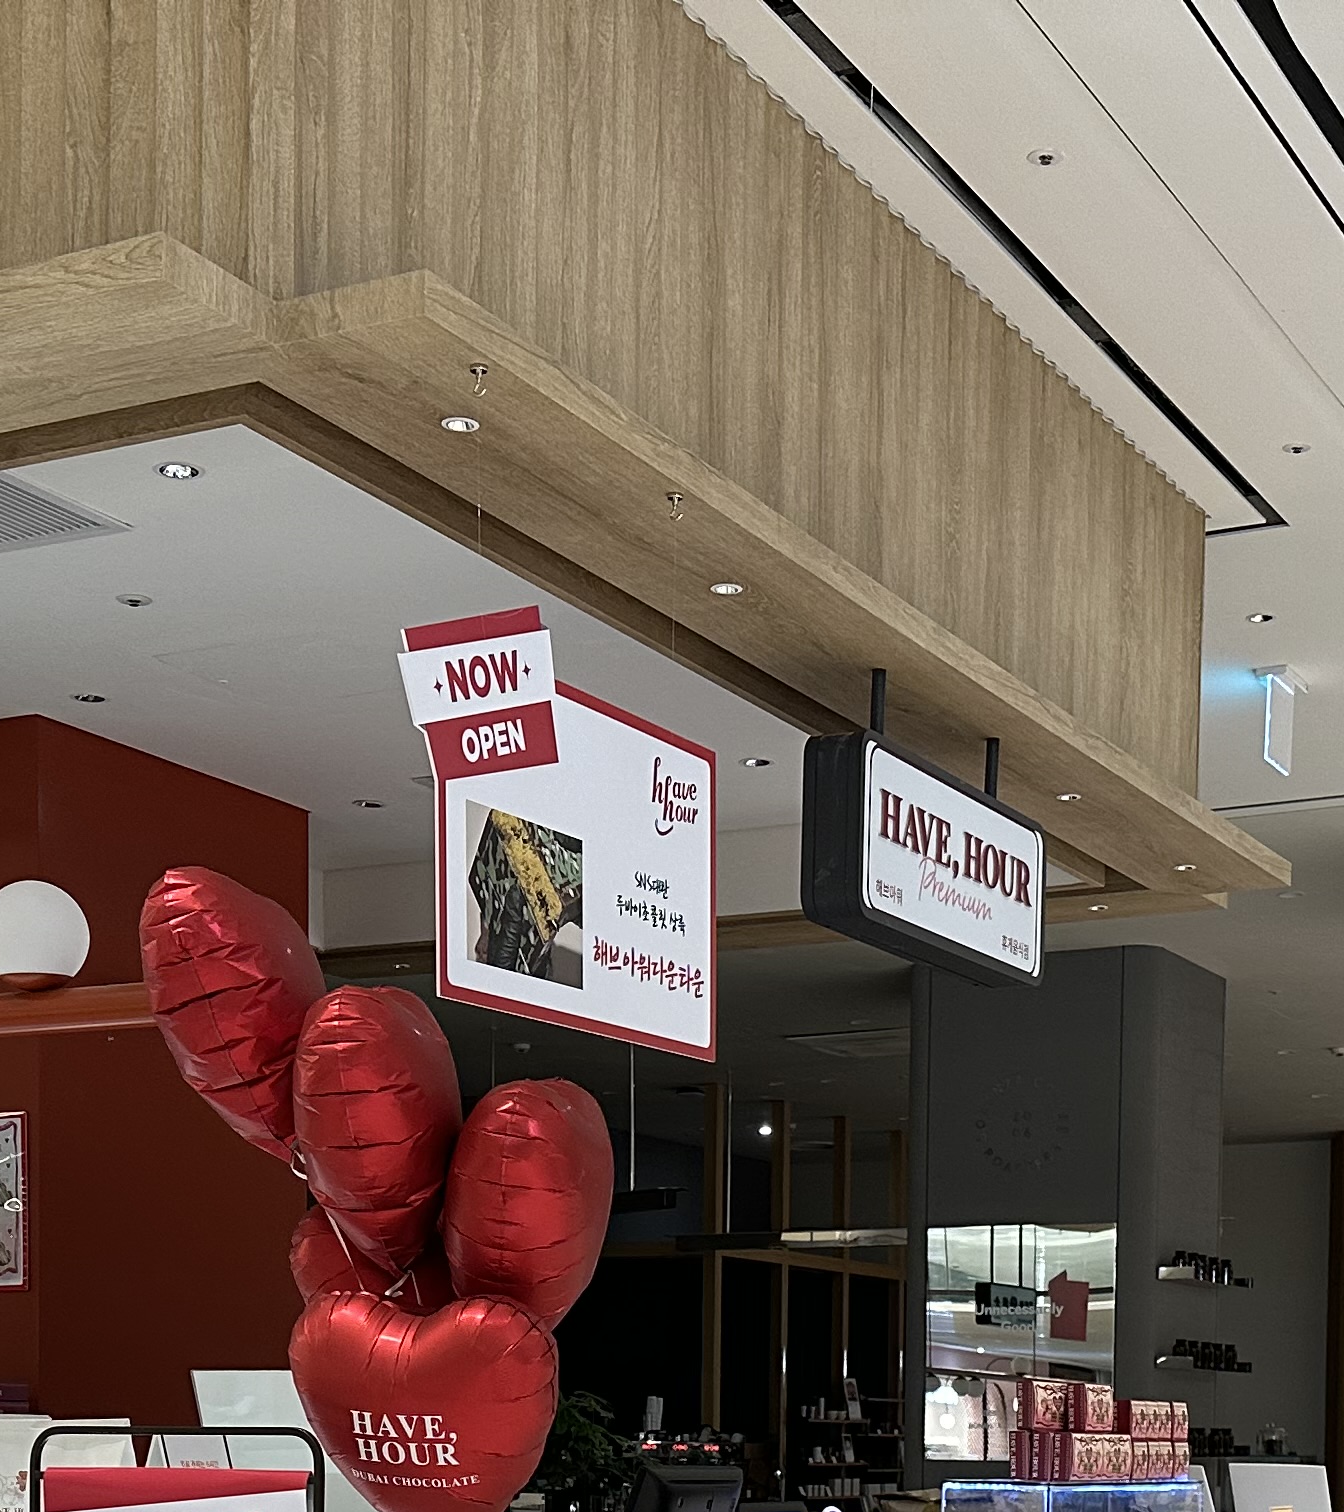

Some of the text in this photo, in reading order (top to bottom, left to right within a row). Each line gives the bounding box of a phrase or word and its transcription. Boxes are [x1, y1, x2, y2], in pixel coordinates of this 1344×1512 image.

[445, 649, 518, 703] NOW
[461, 719, 526, 764] OPEN
[879, 788, 1032, 907] HAVE, HOUR
[918, 856, 992, 920] Premium
[592, 936, 704, 998] 해브아워다운타운
[976, 1302, 1064, 1317] Unnecessly
[350, 1409, 458, 1444] HAVE,
[355, 1437, 459, 1466] HOUR
[351, 1467, 480, 1488] DUBAI CHOCOLATE
